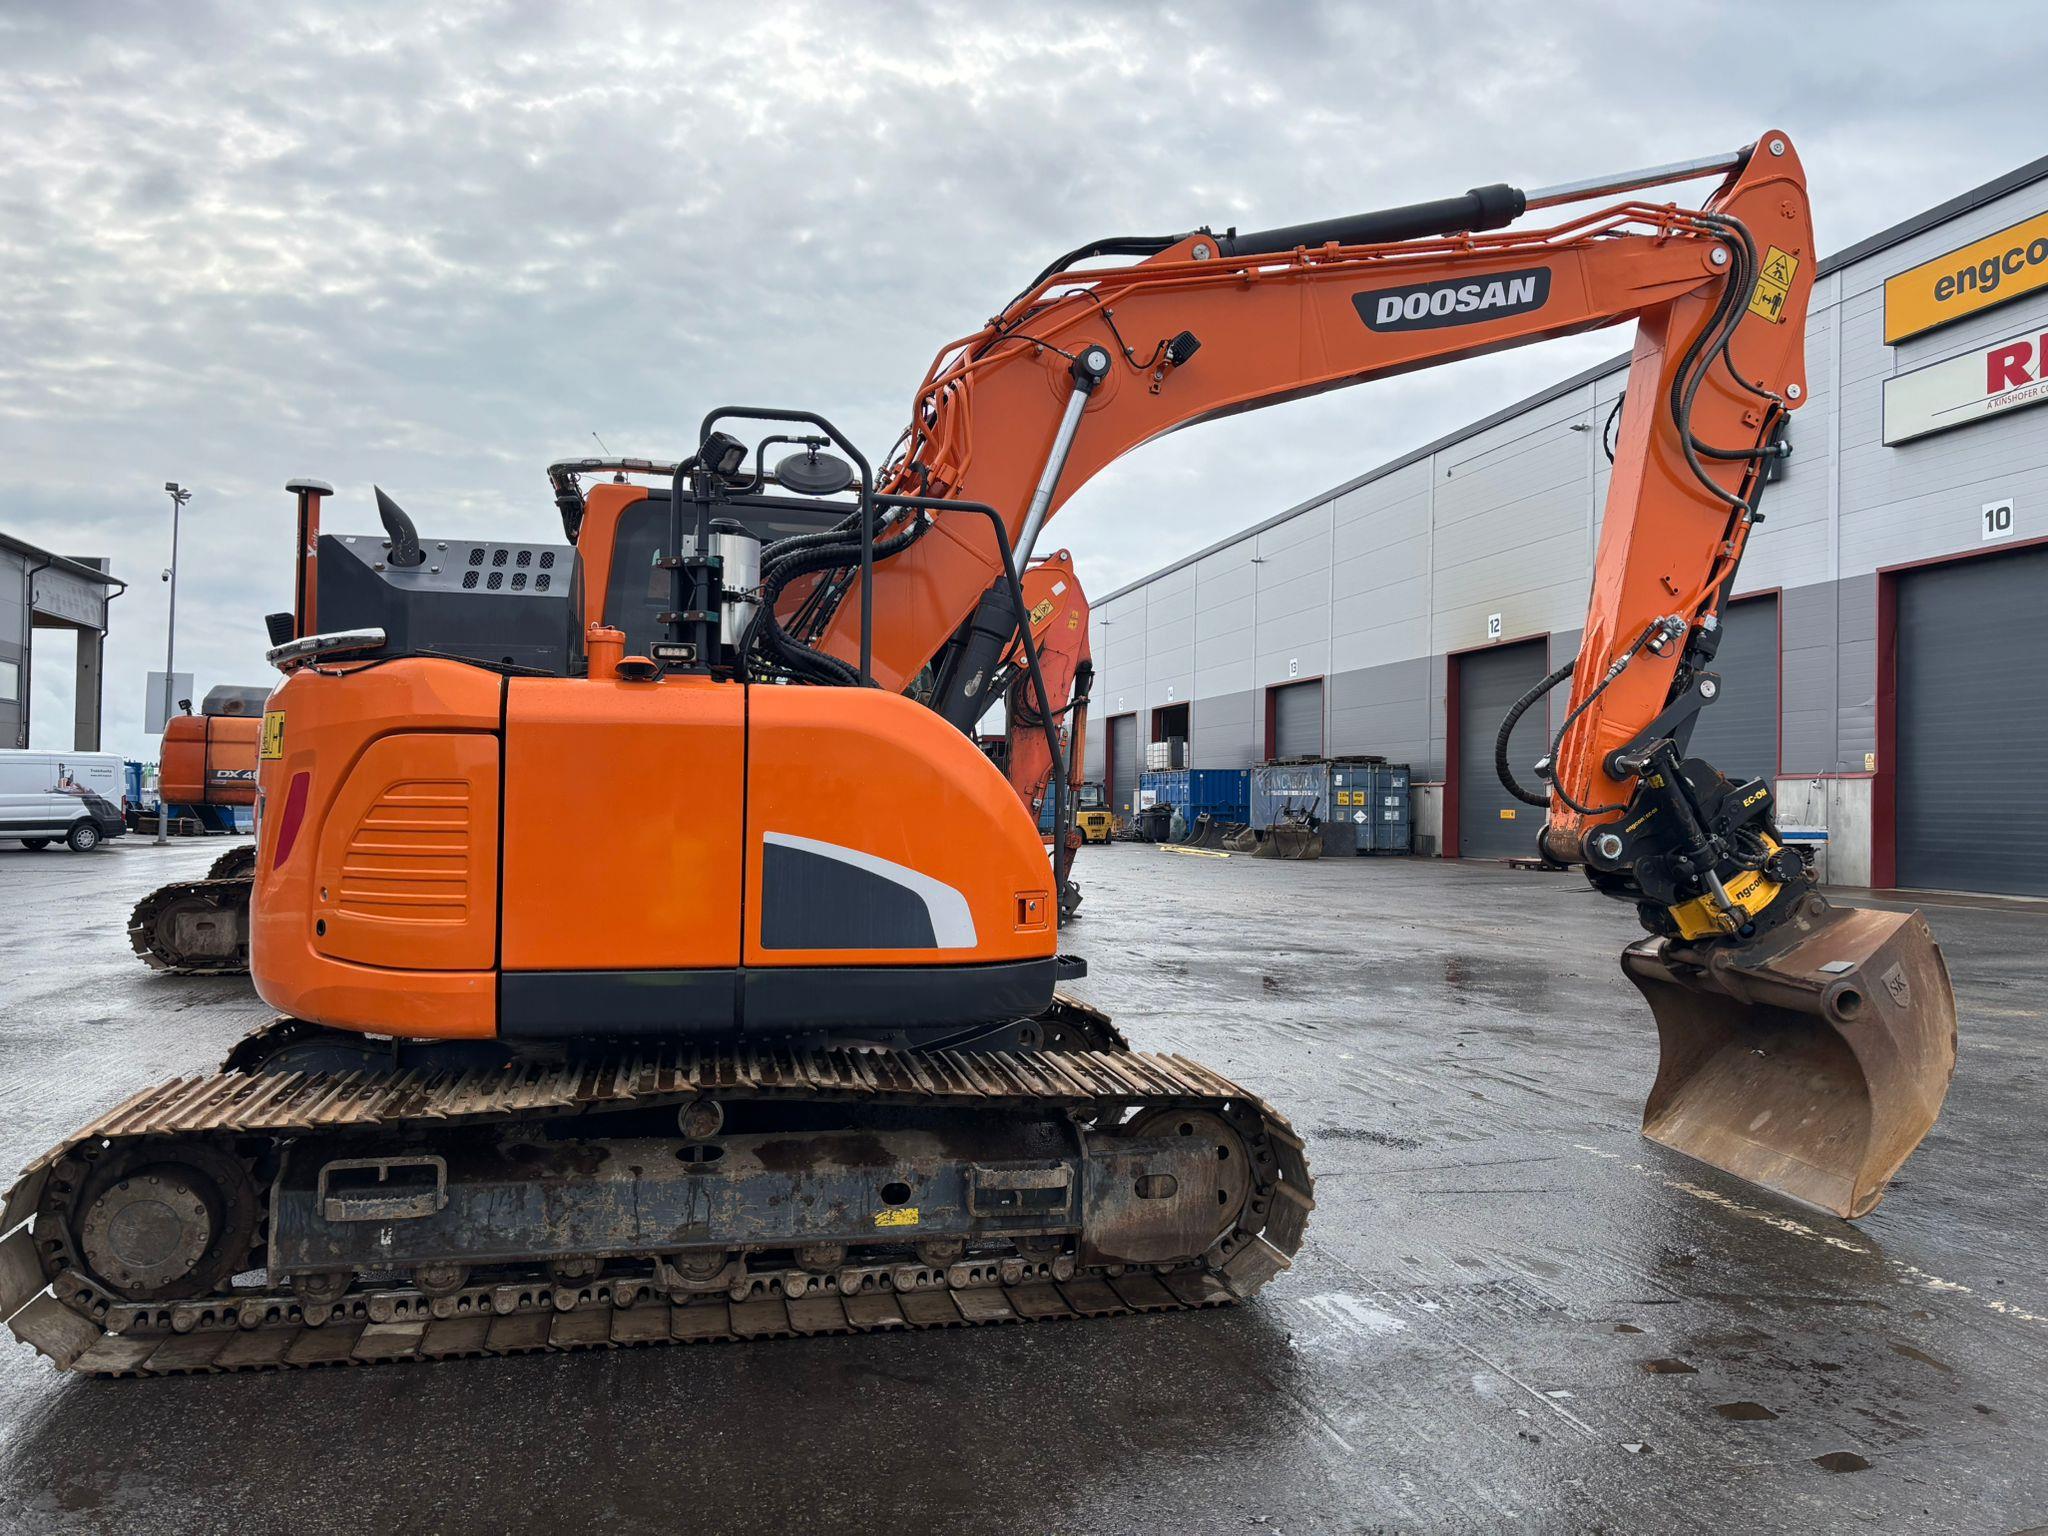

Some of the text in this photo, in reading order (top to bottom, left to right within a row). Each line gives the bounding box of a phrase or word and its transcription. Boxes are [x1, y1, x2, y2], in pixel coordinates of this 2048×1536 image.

[1376, 276, 1536, 325] DOOSAN
[1987, 332, 2048, 395] R
[1987, 400, 1993, 410] A
[1994, 387, 2039, 408] KINSHOFER
[1984, 506, 2011, 532] 10
[1489, 618, 1500, 634] 12
[216, 769, 245, 778] DX
[1743, 788, 1768, 808] EC-Oil
